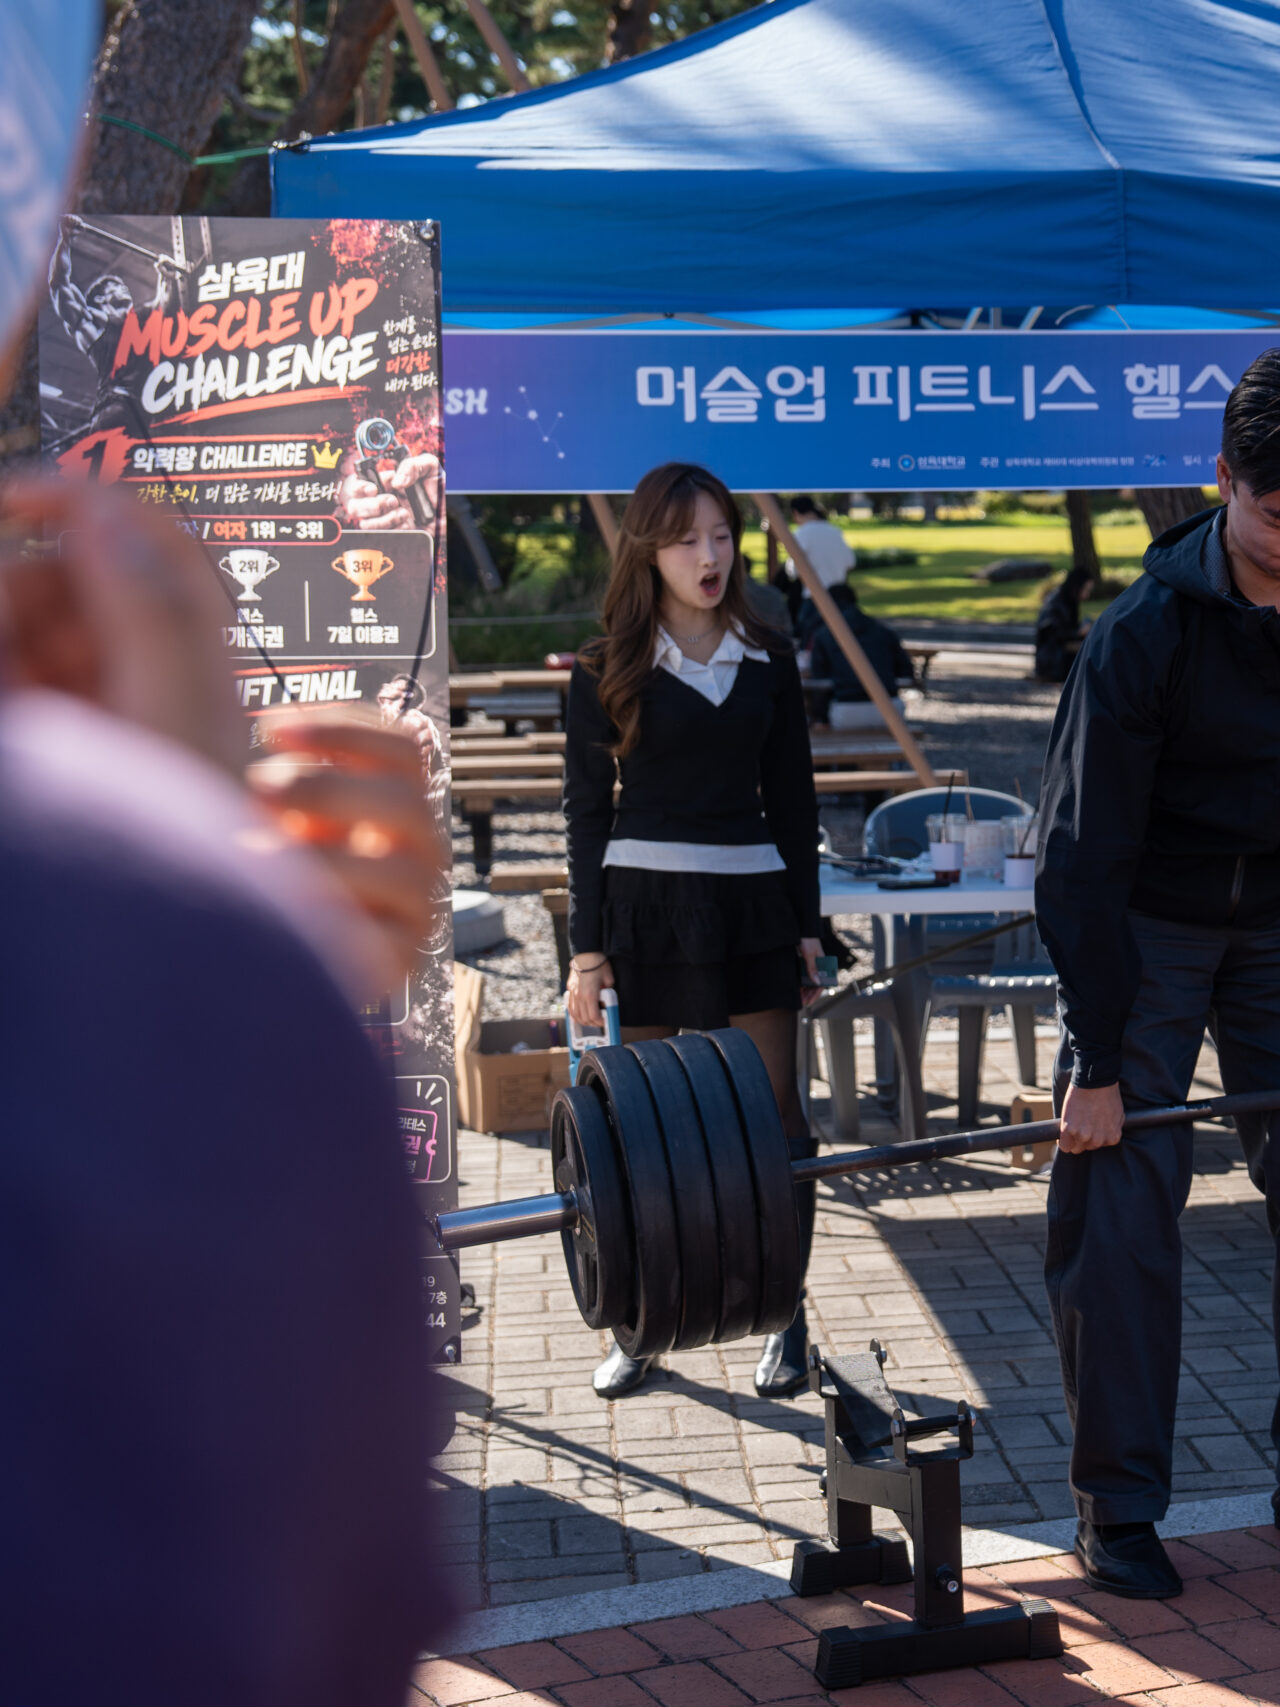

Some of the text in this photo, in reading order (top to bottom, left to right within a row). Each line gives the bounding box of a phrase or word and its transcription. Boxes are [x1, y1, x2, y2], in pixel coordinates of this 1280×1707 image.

[199, 251, 306, 302] 삼육대
[111, 277, 380, 381] MUSCLE UP
[383, 315, 417, 337] 한계를
[388, 336, 410, 355] 넘는
[142, 331, 380, 414] CHALLENGE
[385, 371, 438, 392] 내가 된다.
[443, 387, 488, 415] SH
[636, 365, 827, 423] 머슬업
[853, 364, 1099, 422] 피트니스
[1123, 363, 1235, 419] 헬스
[133, 443, 307, 473] 악력왕 CHALLENGE
[137, 484, 167, 503] 강한
[205, 485, 218, 503] 더
[223, 484, 250, 504] 많은
[253, 482, 292, 503] 기회를
[294, 480, 342, 503] 만든다!
[213, 521, 247, 539] 여자
[251, 520, 276, 539] 1위
[296, 520, 324, 540] 3위
[239, 559, 259, 574] 2위
[352, 559, 373, 574] 3위
[350, 607, 378, 624] 헬스
[327, 626, 400, 644] 7일 이용권
[281, 670, 362, 704] FINAL
